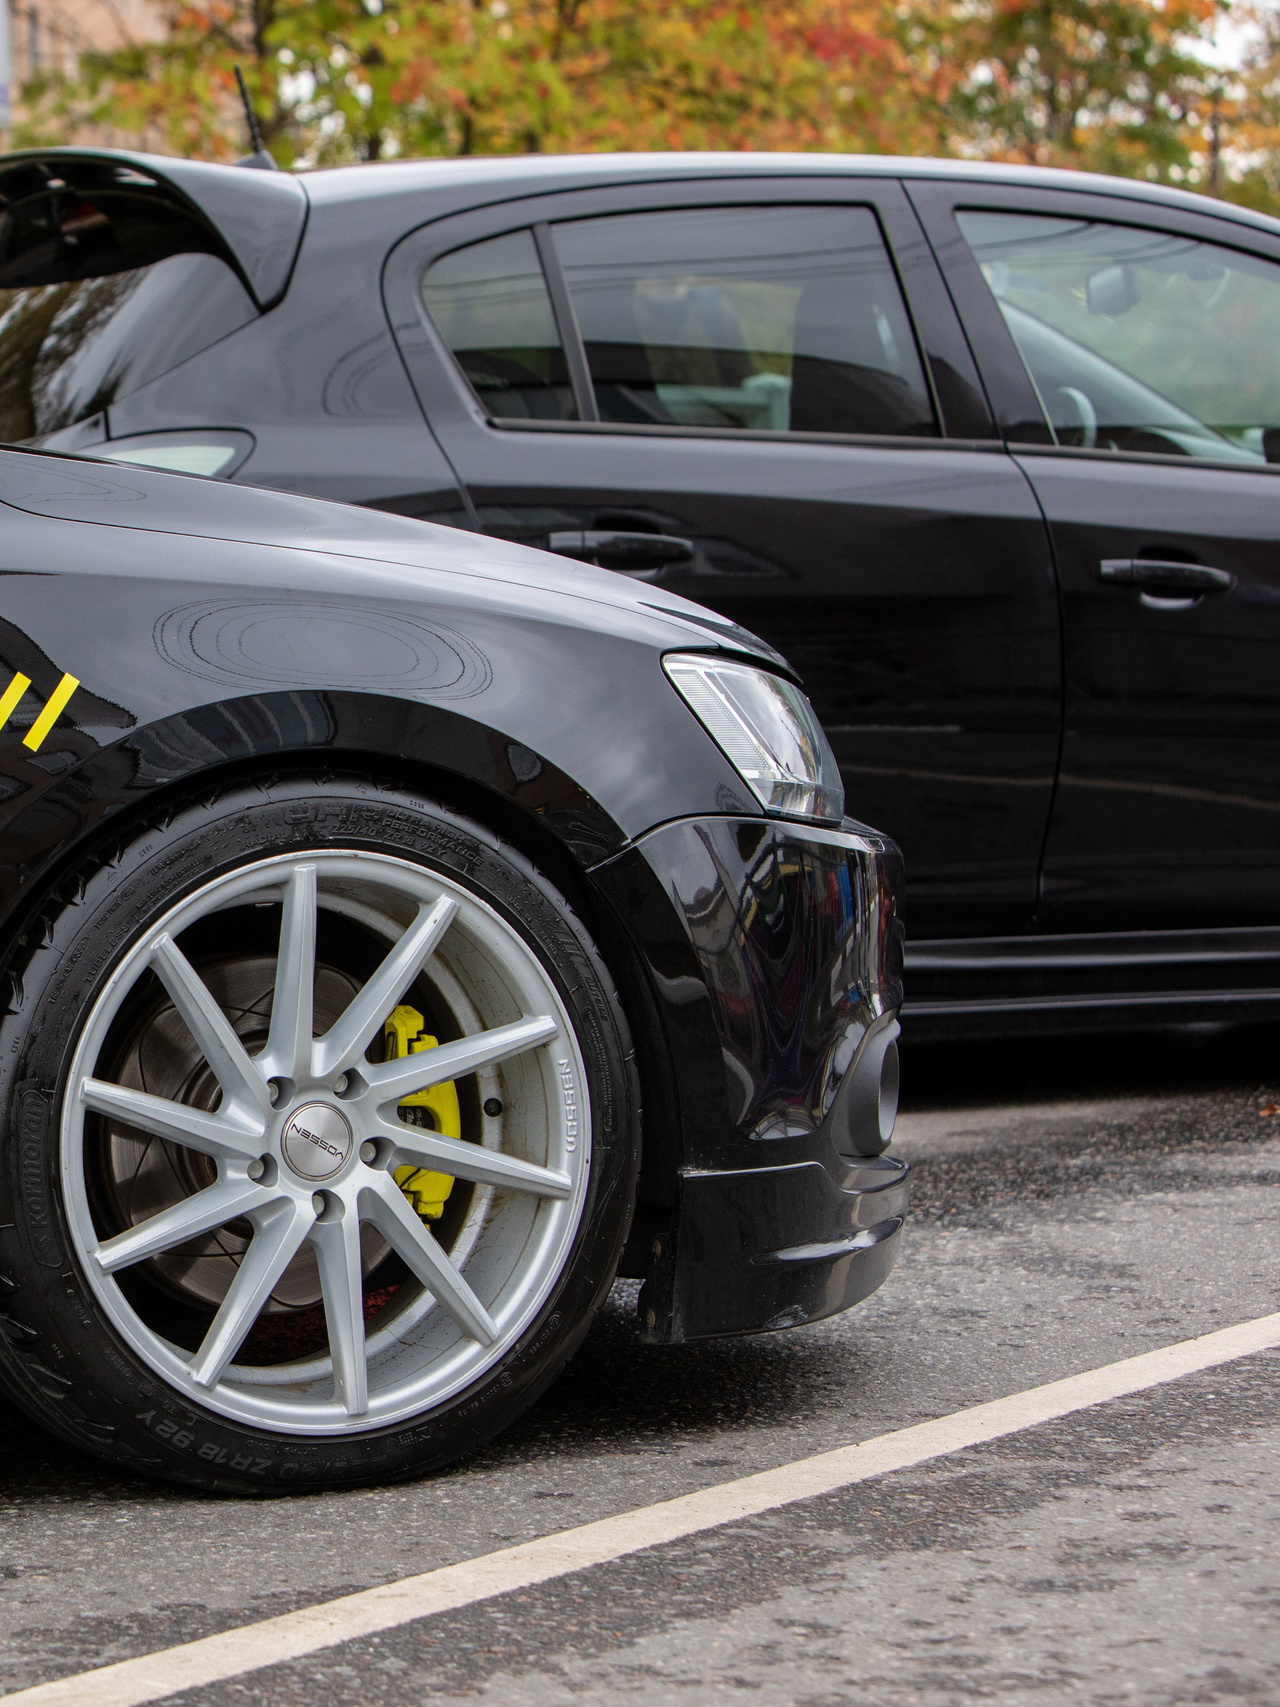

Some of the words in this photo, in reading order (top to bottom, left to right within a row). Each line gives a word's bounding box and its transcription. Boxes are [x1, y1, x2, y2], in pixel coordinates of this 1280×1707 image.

[84, 922, 131, 984] TUBELESS
[23, 1100, 49, 1230] kormoran
[290, 1123, 345, 1161] VOSSEN
